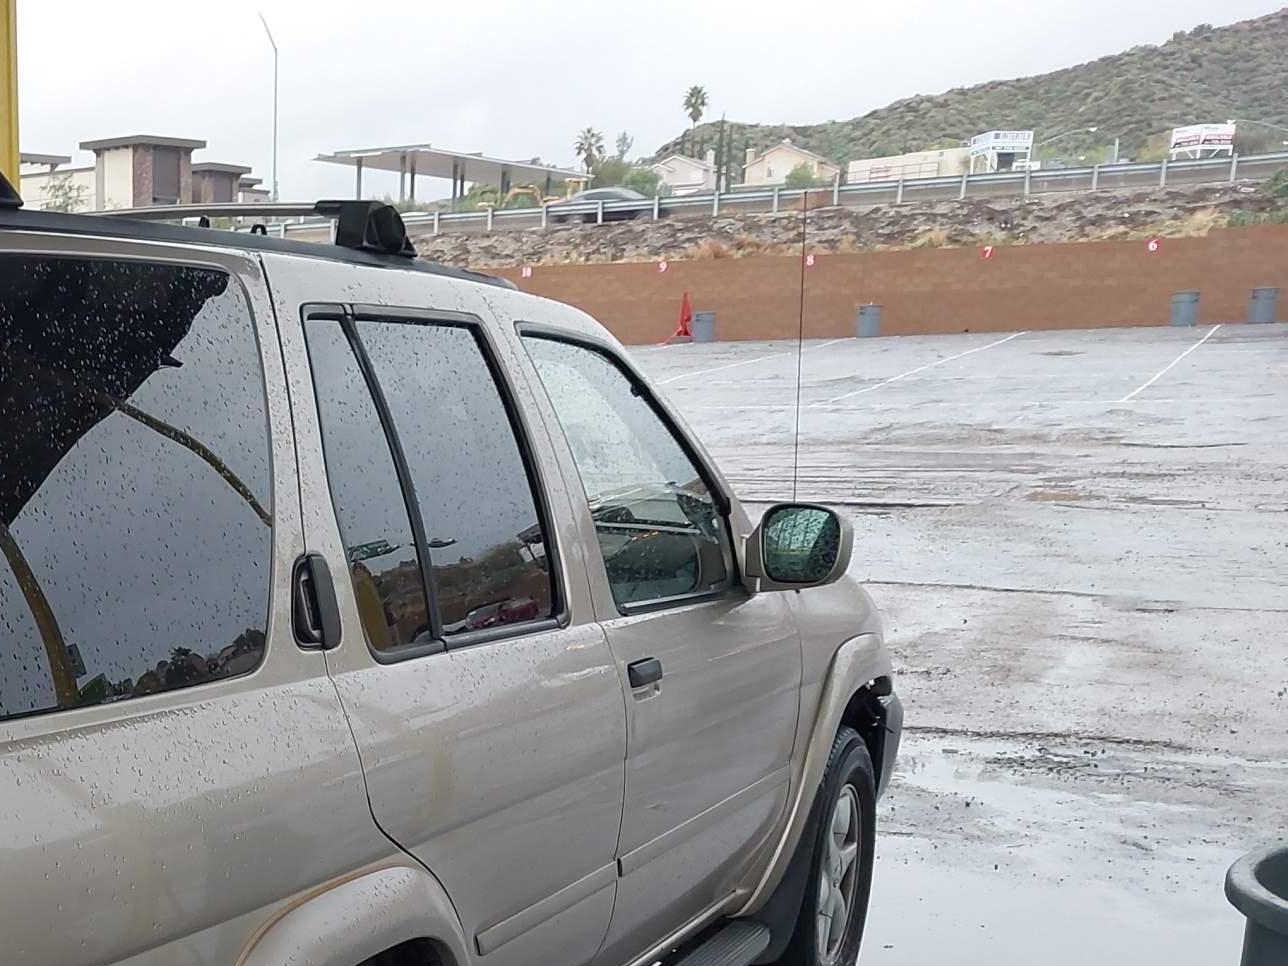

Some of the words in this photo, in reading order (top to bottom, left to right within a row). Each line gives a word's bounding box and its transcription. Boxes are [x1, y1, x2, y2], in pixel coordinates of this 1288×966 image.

[1148, 239, 1158, 251] 6
[984, 246, 993, 258] 7
[659, 261, 667, 272] 9
[806, 255, 814, 266] 8
[521, 266, 532, 278] 10
